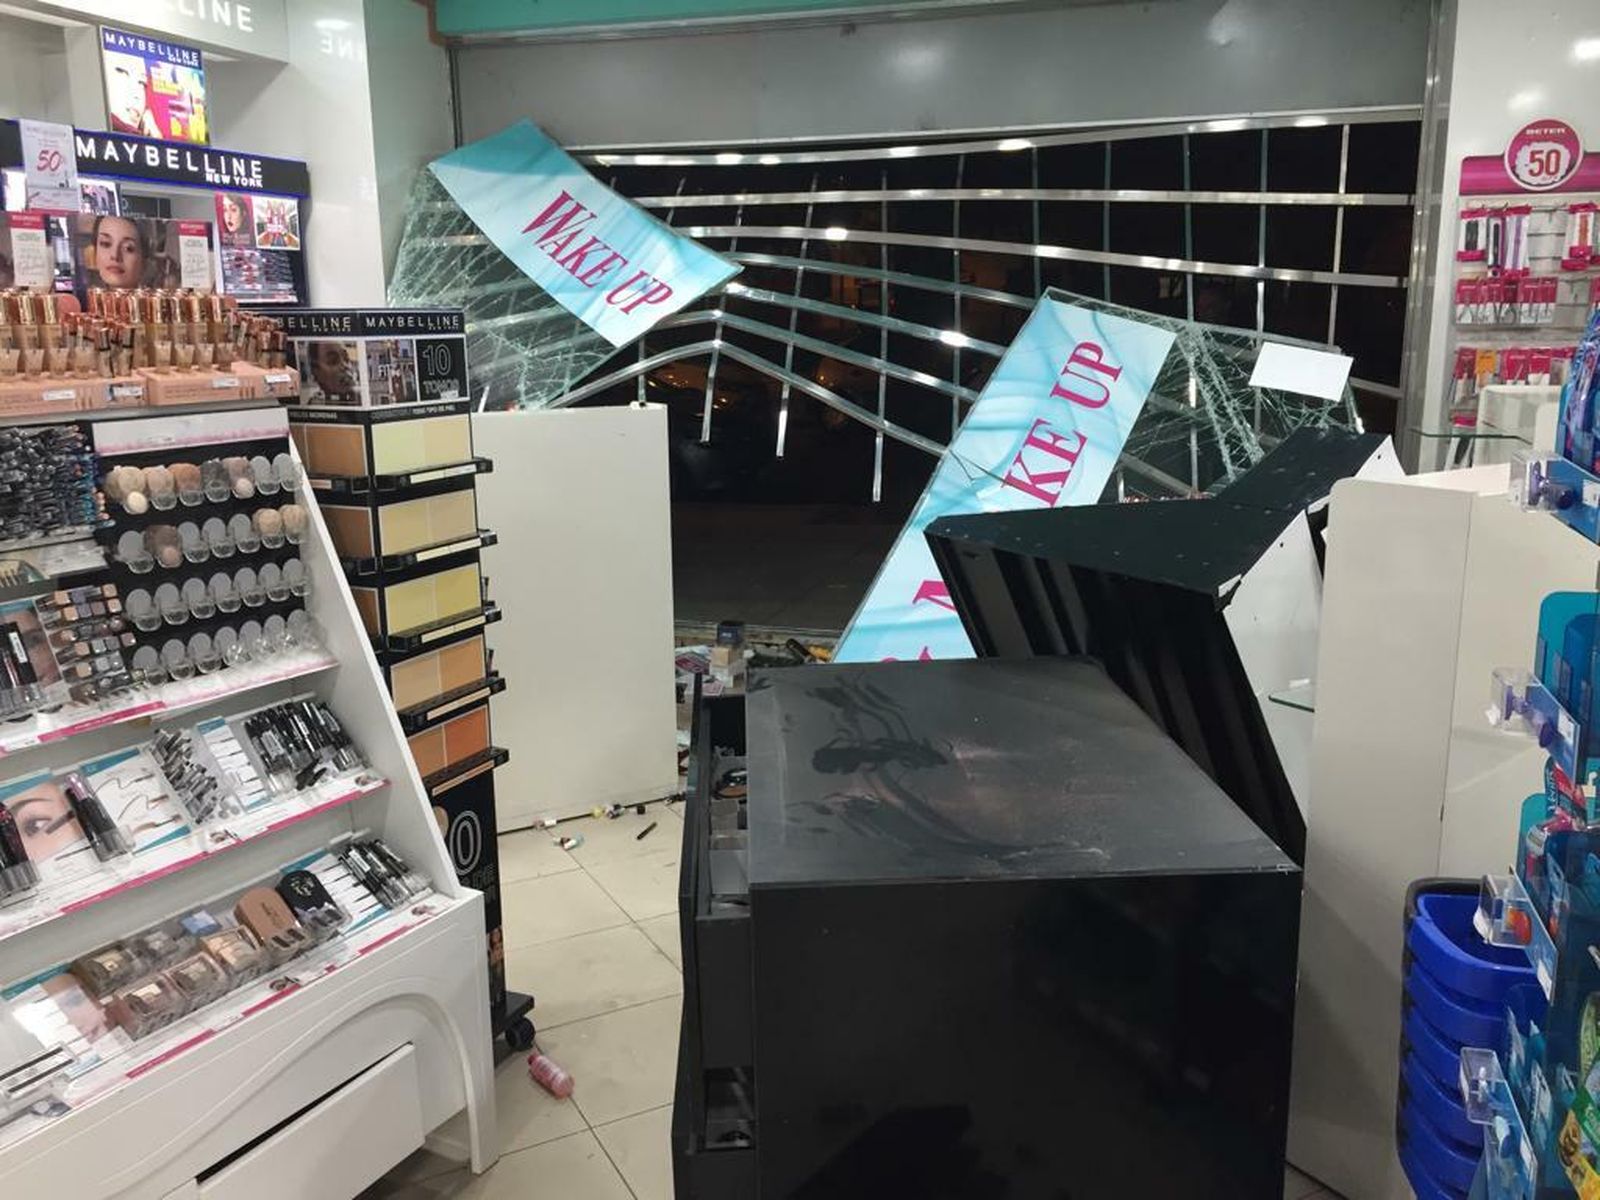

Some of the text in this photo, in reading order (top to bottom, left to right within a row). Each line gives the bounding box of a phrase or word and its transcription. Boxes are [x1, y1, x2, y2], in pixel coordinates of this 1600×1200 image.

[105, 32, 199, 60] MAYBELLINE
[76, 136, 263, 179] MAYBELLINE
[1528, 149, 1562, 177] 50
[206, 173, 263, 188] NEW YORK
[521, 189, 674, 315] WAKE UP
[366, 315, 460, 328] MAYBELLINE
[423, 343, 452, 376] 10
[1050, 341, 1123, 409] UP
